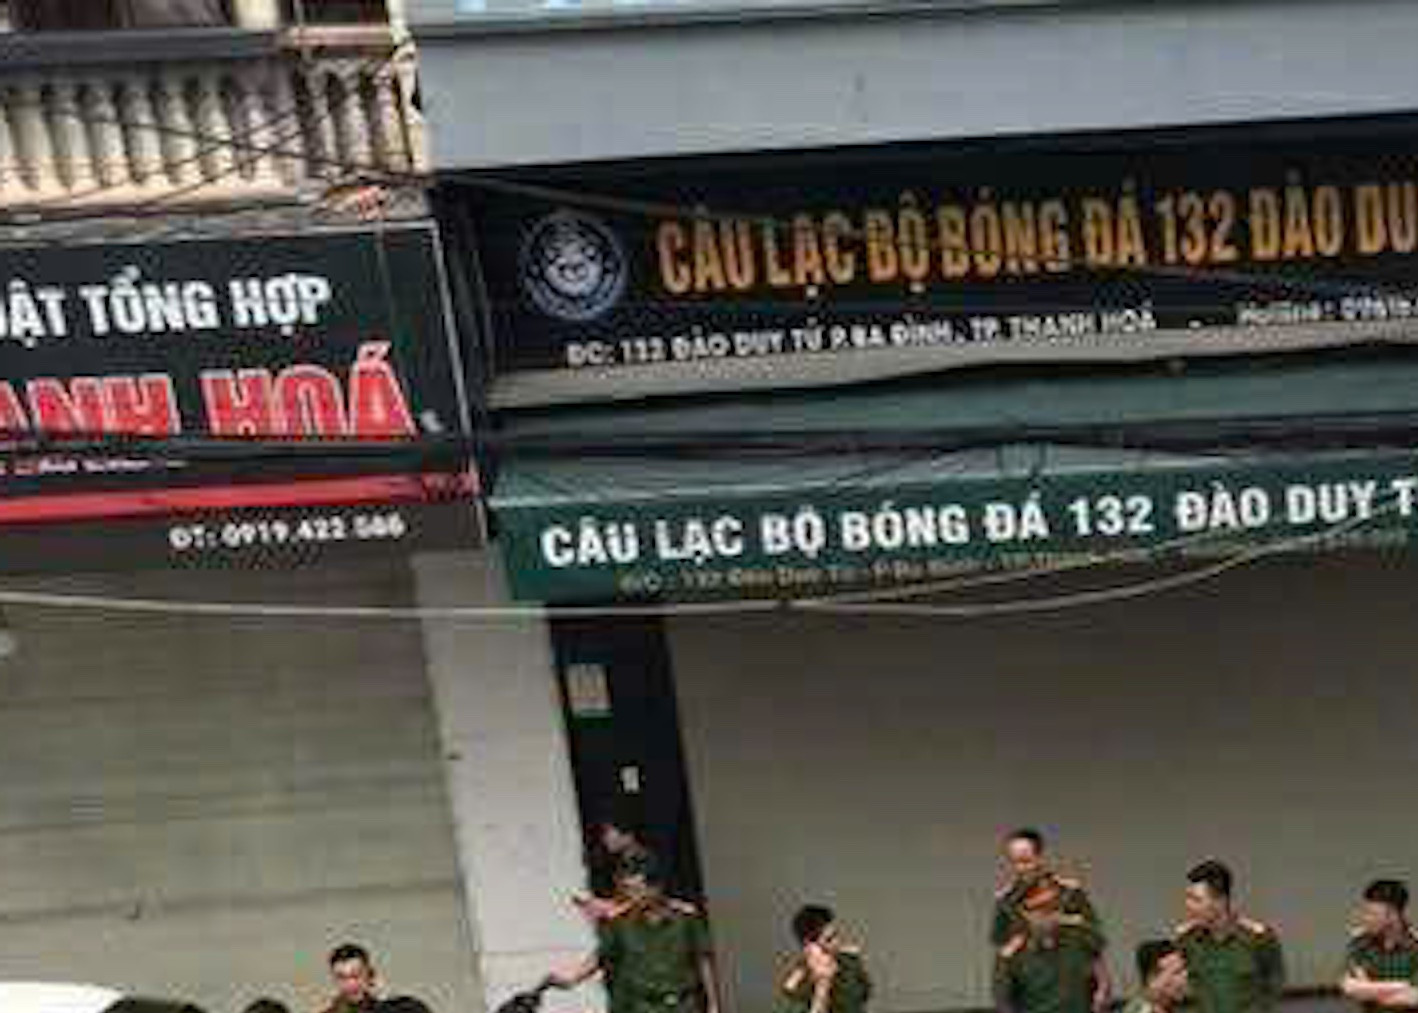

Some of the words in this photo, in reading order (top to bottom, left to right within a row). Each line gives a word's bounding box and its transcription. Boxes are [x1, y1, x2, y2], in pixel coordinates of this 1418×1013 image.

[658, 205, 757, 293] CÂU
[763, 208, 858, 300] LẠC
[866, 186, 932, 294] BỘ
[936, 185, 1073, 280] BÓNG
[1151, 191, 1240, 266] 132
[0, 278, 68, 348] ẬT
[78, 264, 222, 335] TỔNG
[228, 270, 330, 336] HỢP
[540, 514, 640, 568] CÂU
[653, 514, 744, 567] LẠC
[759, 502, 829, 561] BỘ
[839, 499, 971, 552] BÓNG
[982, 490, 1051, 544] ĐÁ
[1067, 495, 1155, 538] 132
[1174, 480, 1271, 533] ĐÀO
[1284, 479, 1377, 526] DUY
